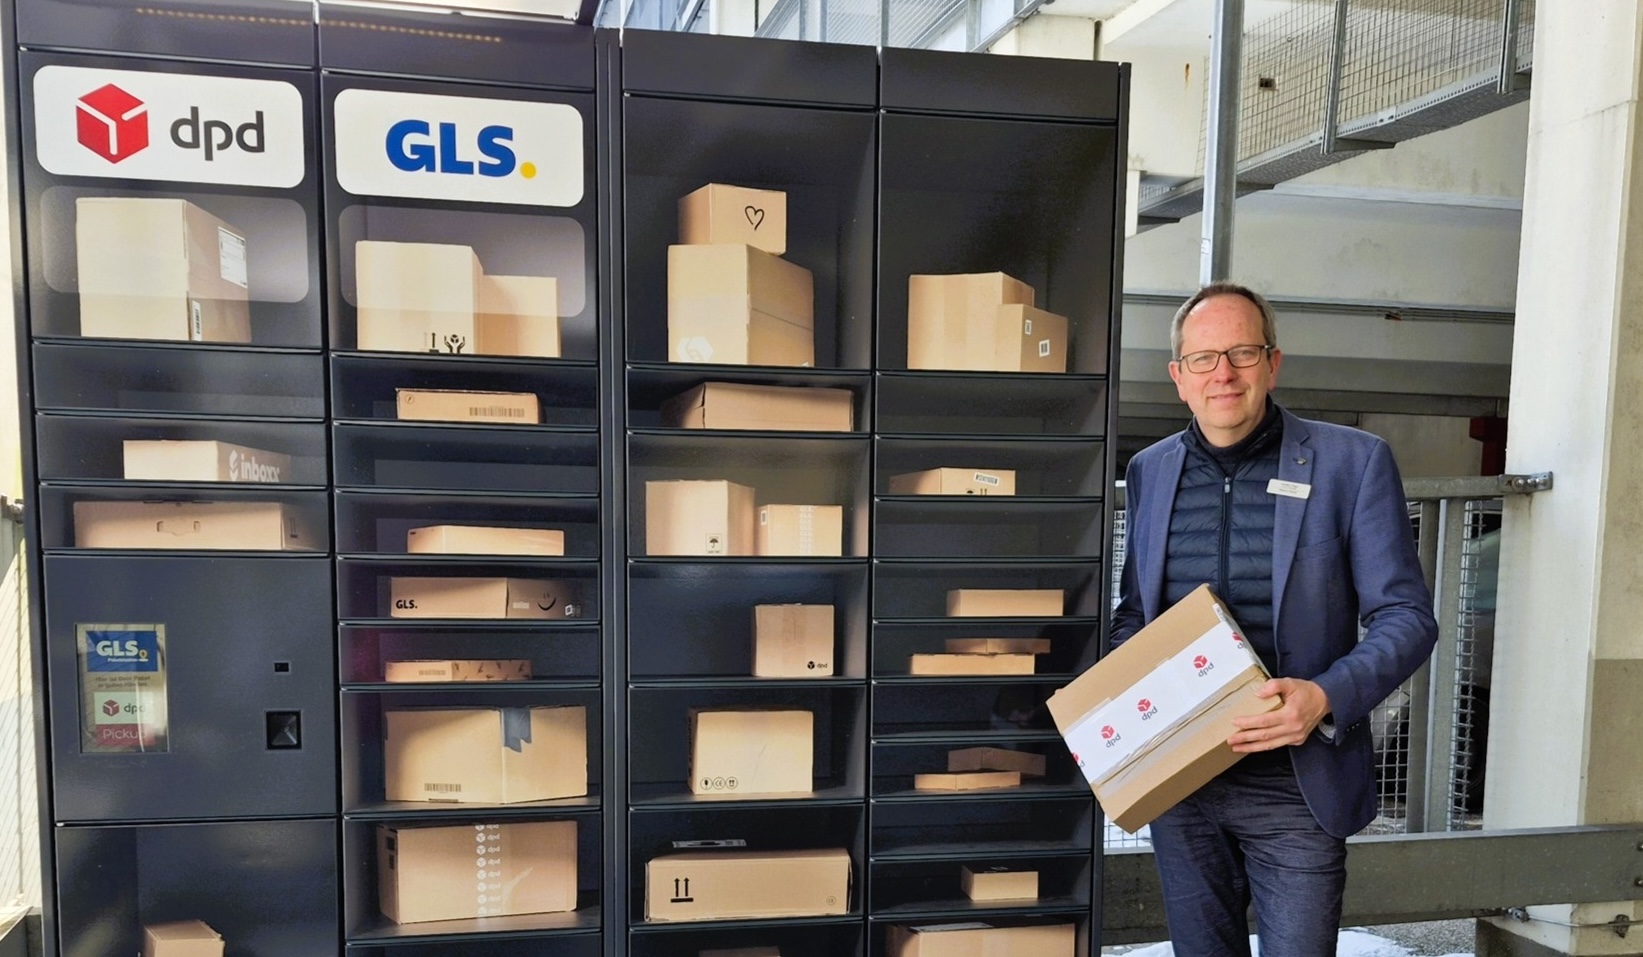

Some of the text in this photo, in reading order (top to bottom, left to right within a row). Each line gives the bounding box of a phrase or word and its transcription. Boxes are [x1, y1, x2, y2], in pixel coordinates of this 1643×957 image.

[170, 105, 265, 161] dpd
[1198, 663, 1214, 677] dpd
[1142, 706, 1158, 721] dpd
[103, 728, 147, 741] Pickup
[1106, 733, 1121, 748] dpd
